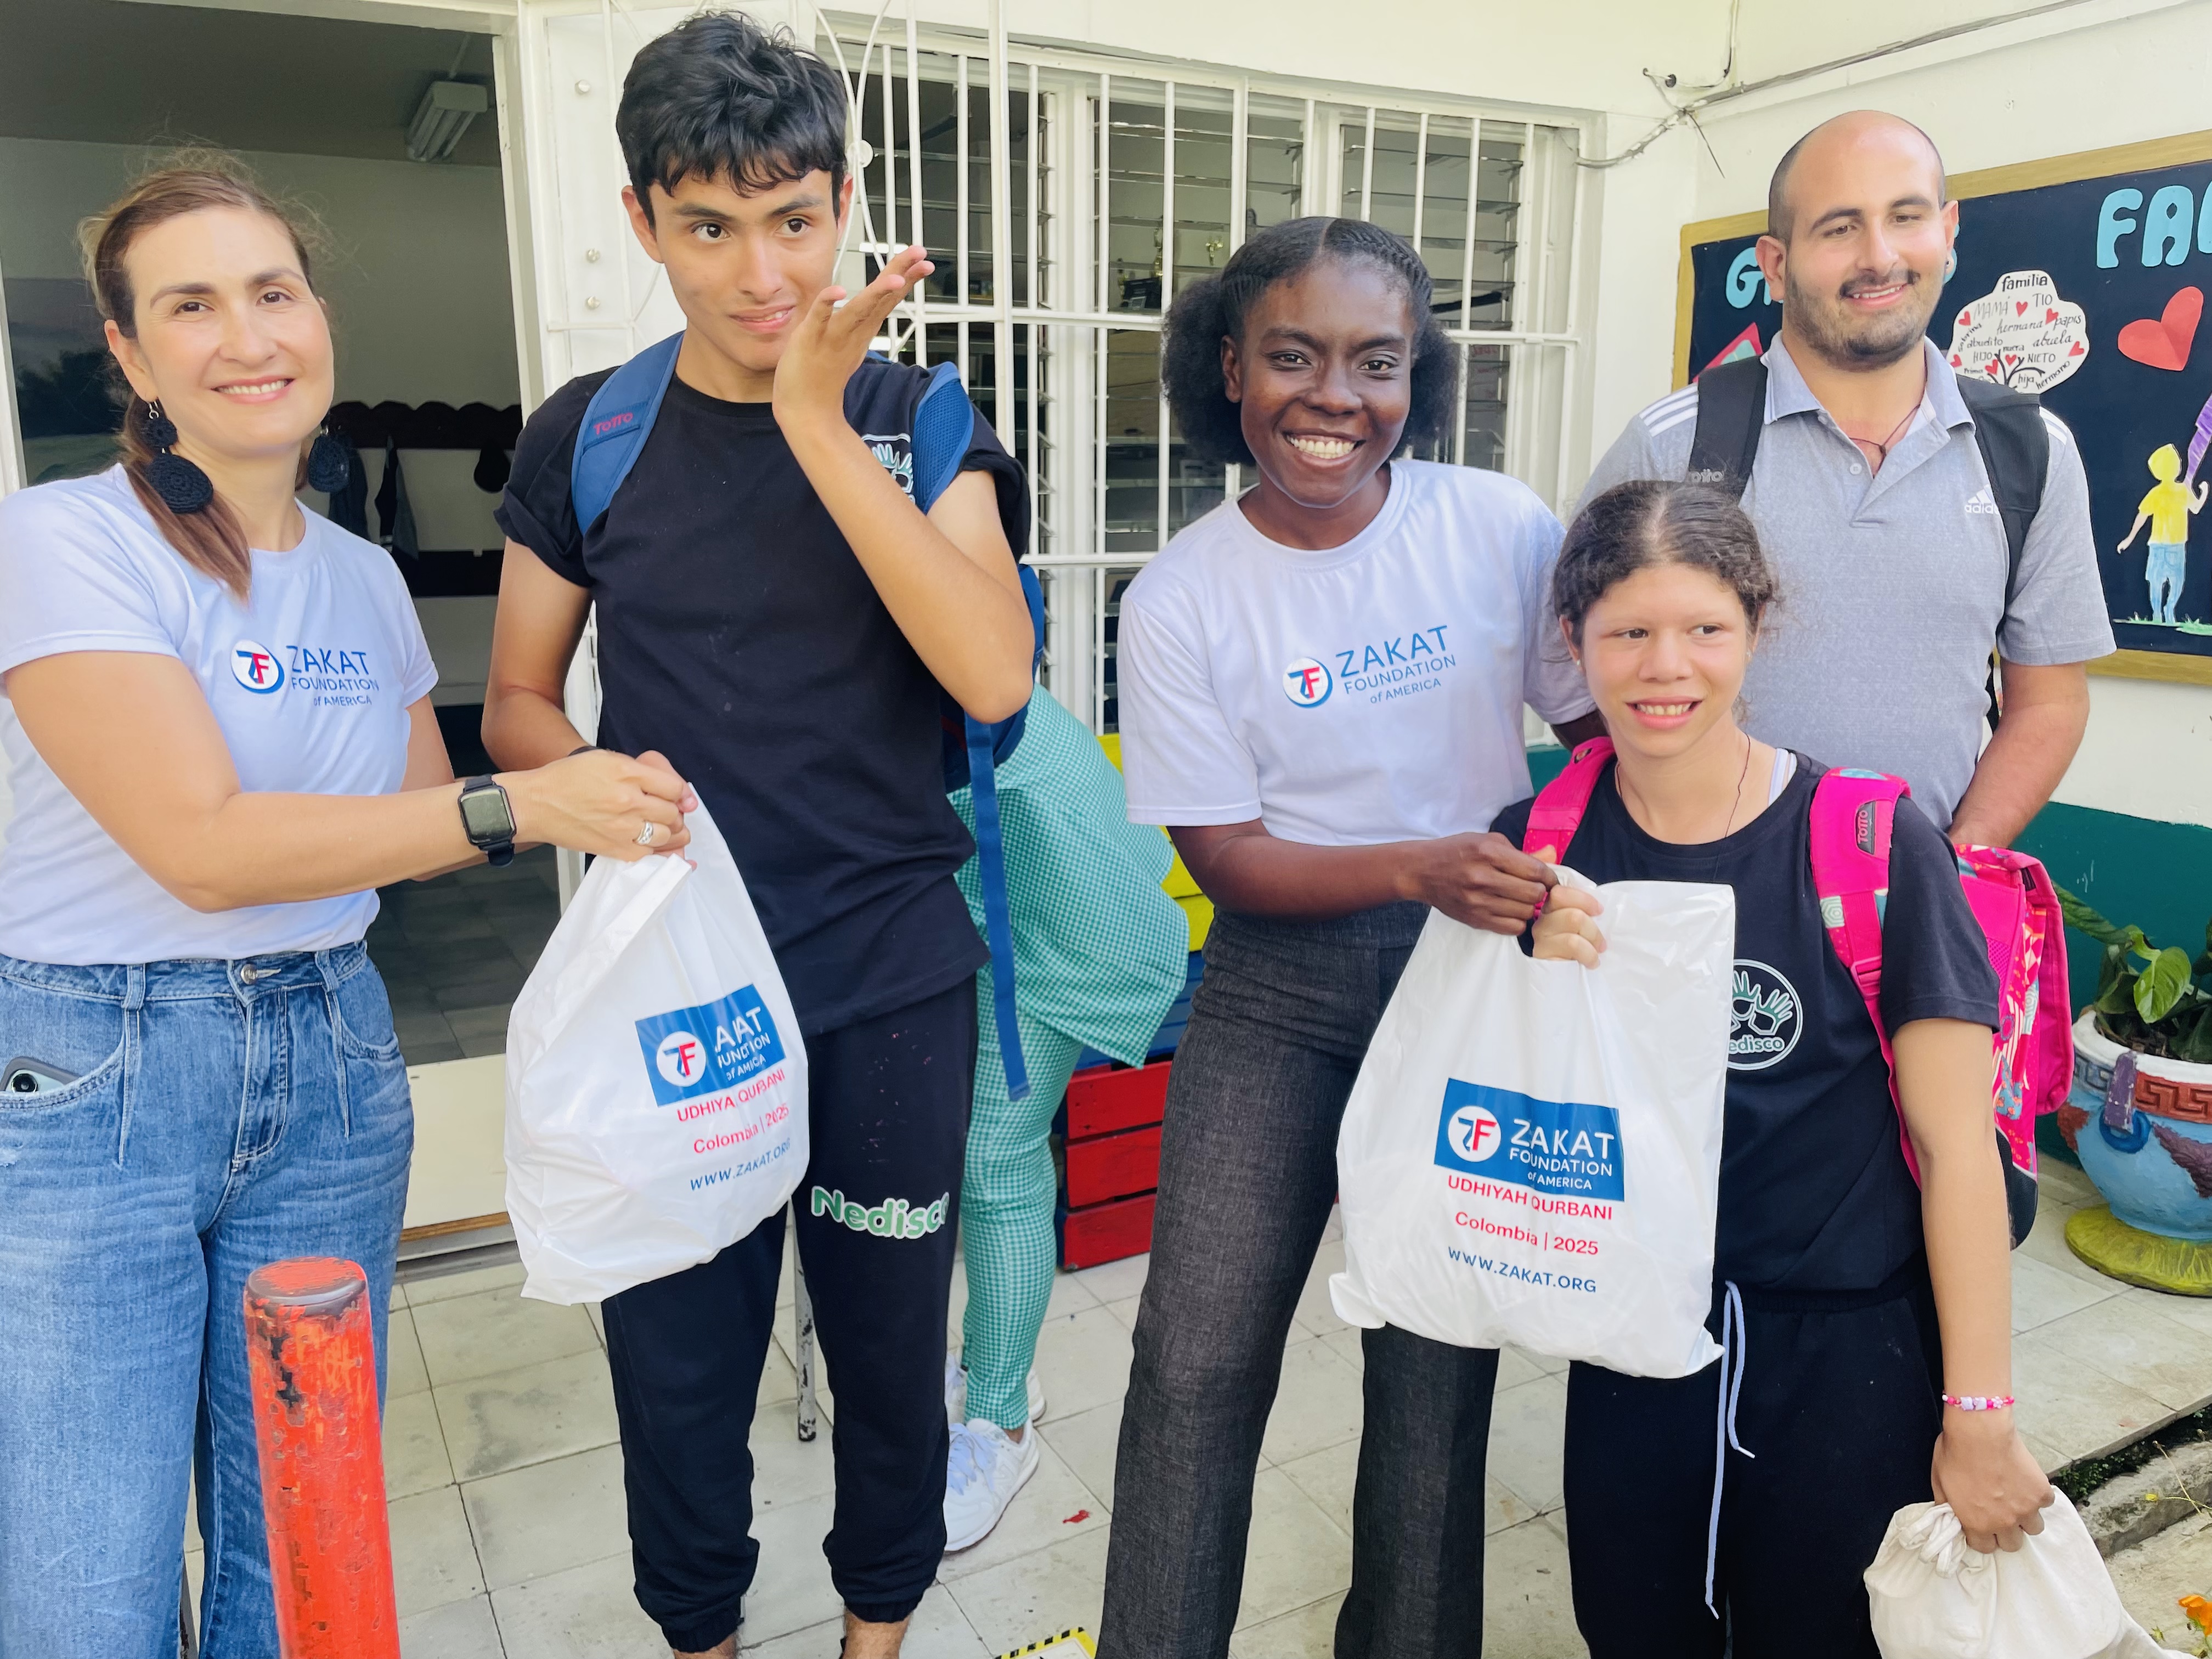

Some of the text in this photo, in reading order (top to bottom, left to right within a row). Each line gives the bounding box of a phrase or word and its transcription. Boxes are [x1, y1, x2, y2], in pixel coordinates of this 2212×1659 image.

[2097, 180, 2212, 269] FA
[2002, 274, 2047, 292] familia
[2033, 293, 2052, 307] TIO
[1997, 319, 2043, 335] hermana
[2033, 330, 2073, 347] abuela
[1973, 351, 1992, 363] HIJO
[2028, 353, 2056, 363] NIETO
[2018, 374, 2034, 388] hija
[2036, 360, 2070, 390] hermano
[1965, 503, 2000, 516] adid
[286, 645, 369, 675] ZAKAT
[1336, 625, 1447, 678] ZAKAT
[291, 677, 379, 691] FOUNDATION
[1344, 654, 1456, 695] FOUNDATION
[313, 695, 372, 706] of AMERICA
[1370, 678, 1441, 704] of AMERICA
[1729, 1035, 1785, 1054] edisco
[765, 1103, 789, 1126] 2025
[1510, 1119, 1614, 1159] ZAKAT
[1509, 1148, 1612, 1177] FOUNDATION
[1527, 1171, 1592, 1190] of AMERICA
[1448, 1175, 1612, 1220] UDHIYAH QURBANI
[1455, 1212, 1537, 1246] Colombia
[1554, 1237, 1598, 1255] 2025
[1448, 1246, 1596, 1293] WWW.ZAKAT.ORG
